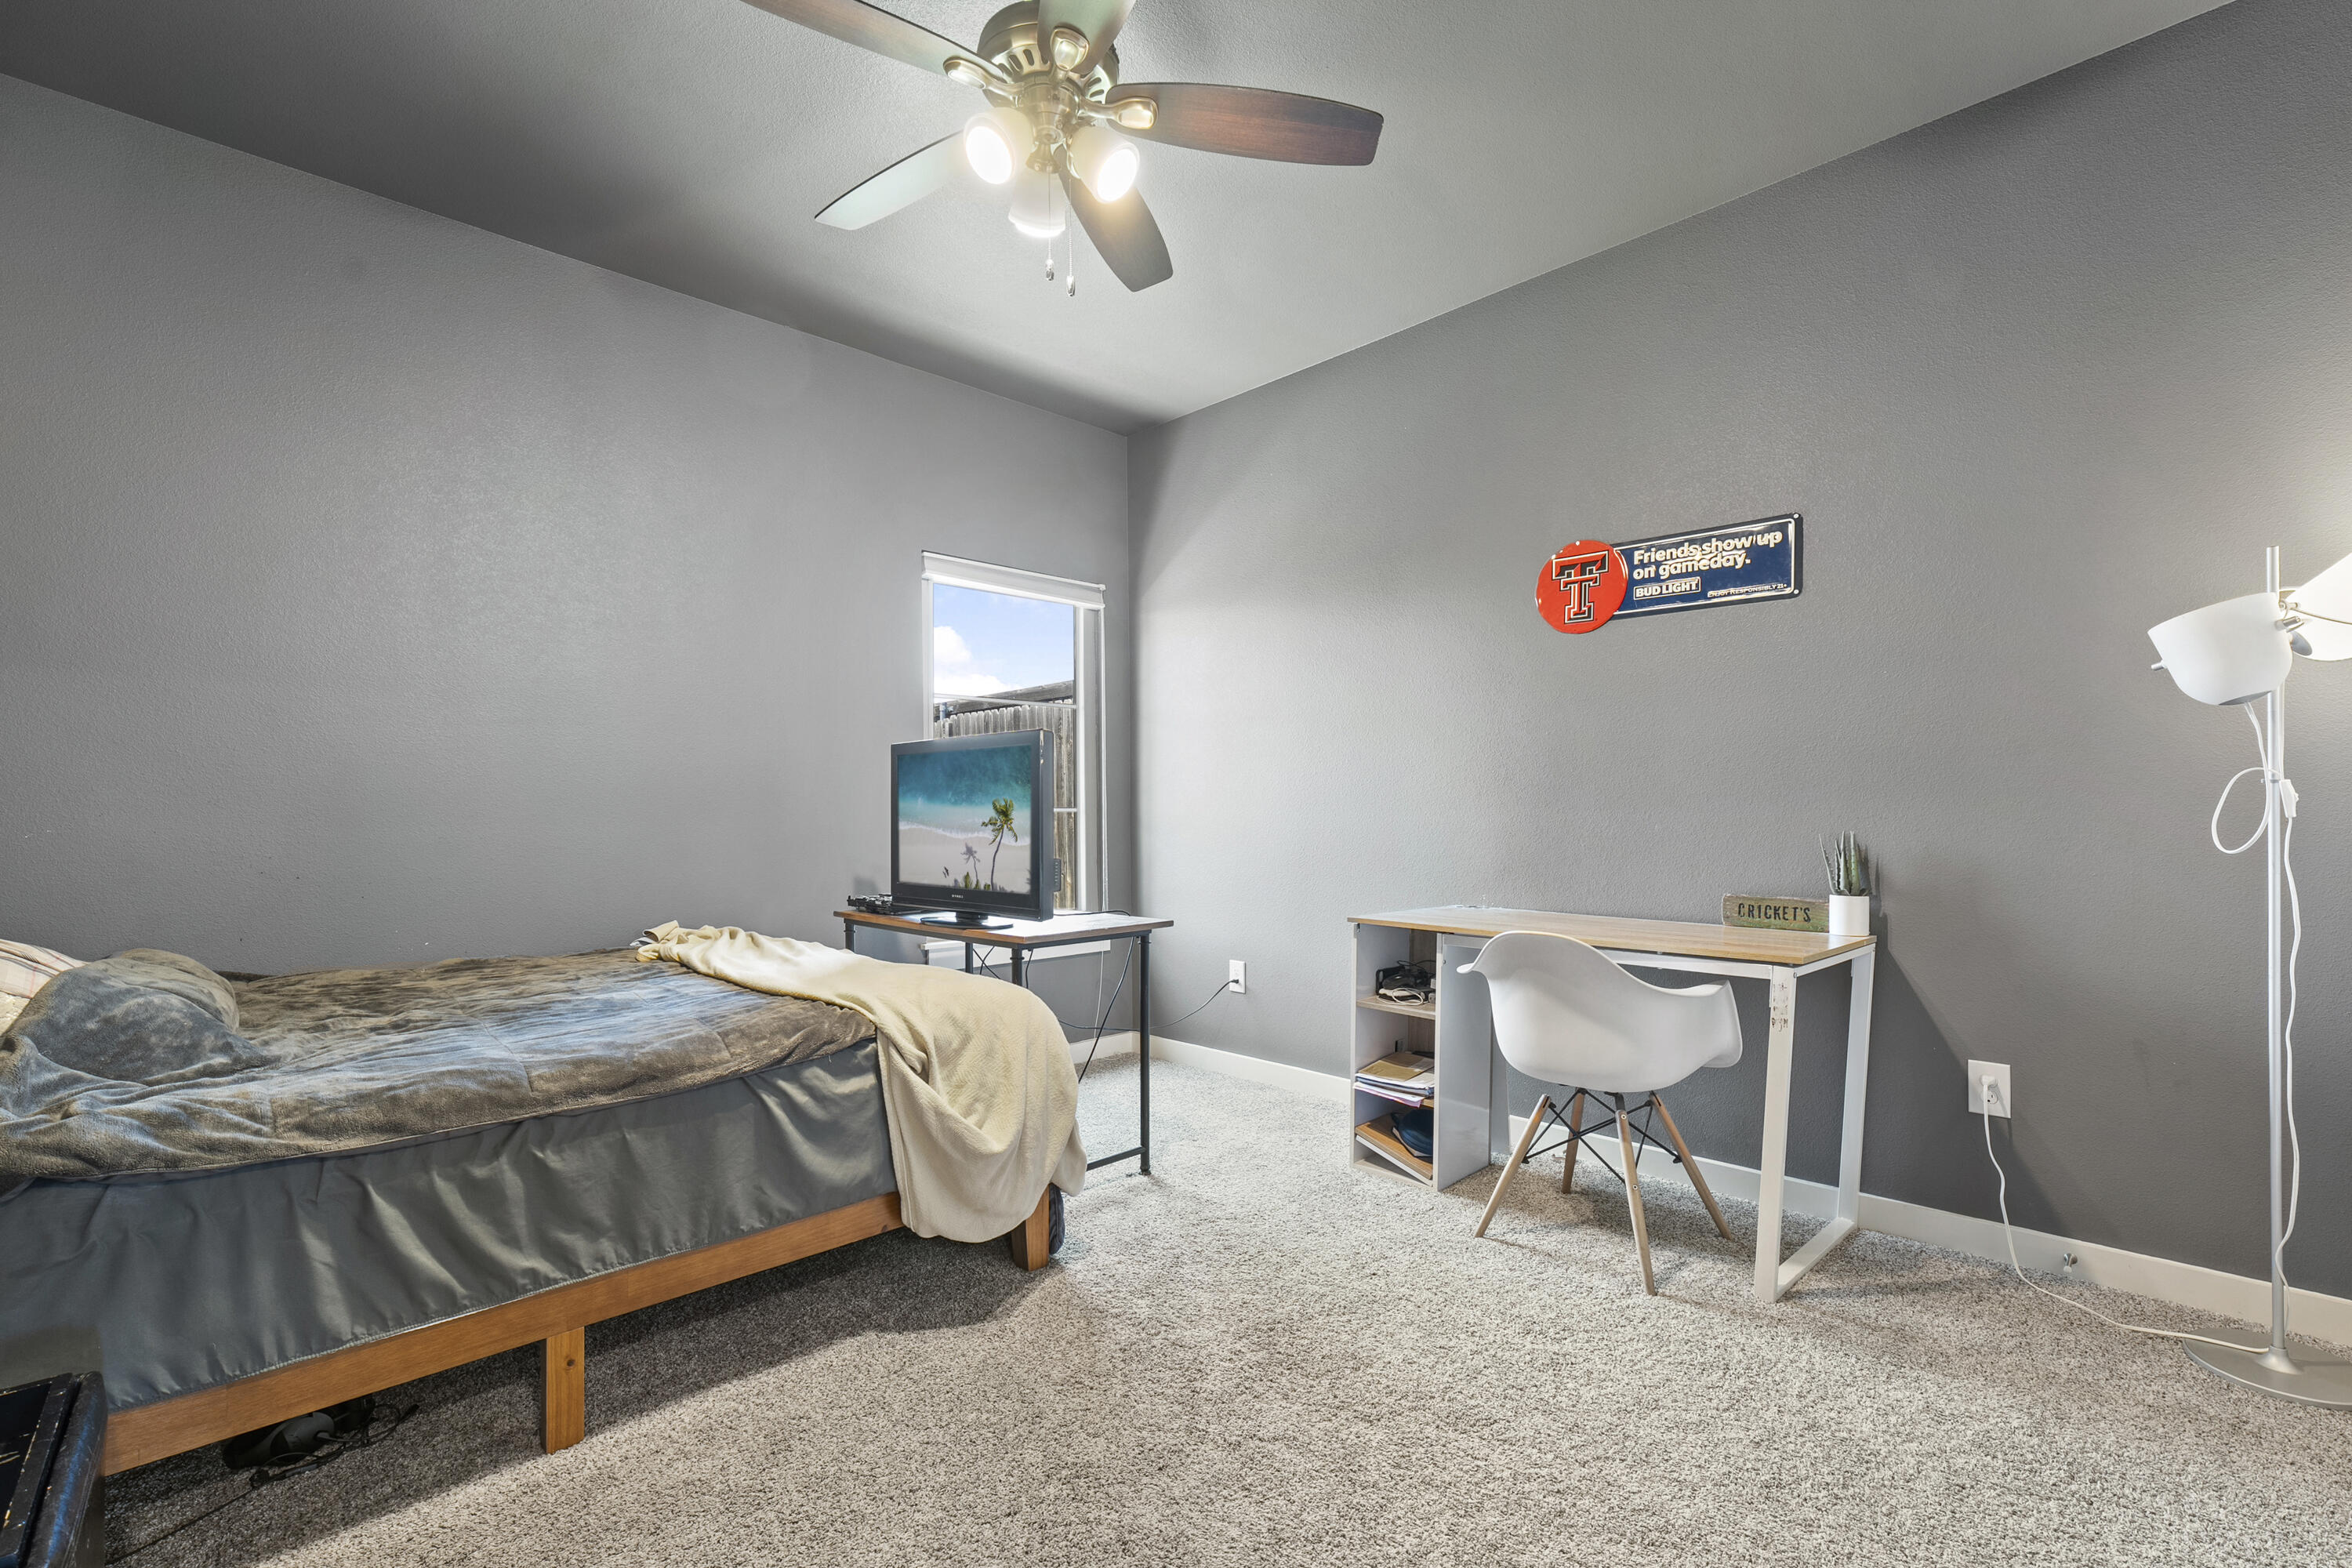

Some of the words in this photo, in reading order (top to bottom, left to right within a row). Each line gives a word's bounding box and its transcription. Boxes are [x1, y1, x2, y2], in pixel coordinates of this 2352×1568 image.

[1633, 542, 1700, 565] Friends
[1701, 537, 1753, 554] show
[1756, 531, 1783, 548] up
[1632, 565, 1656, 580] on
[1658, 552, 1751, 579] gameday.
[1635, 586, 1661, 598] BUD
[1661, 581, 1698, 594] LIGHT
[1737, 902, 1812, 924] CRICKET'S
